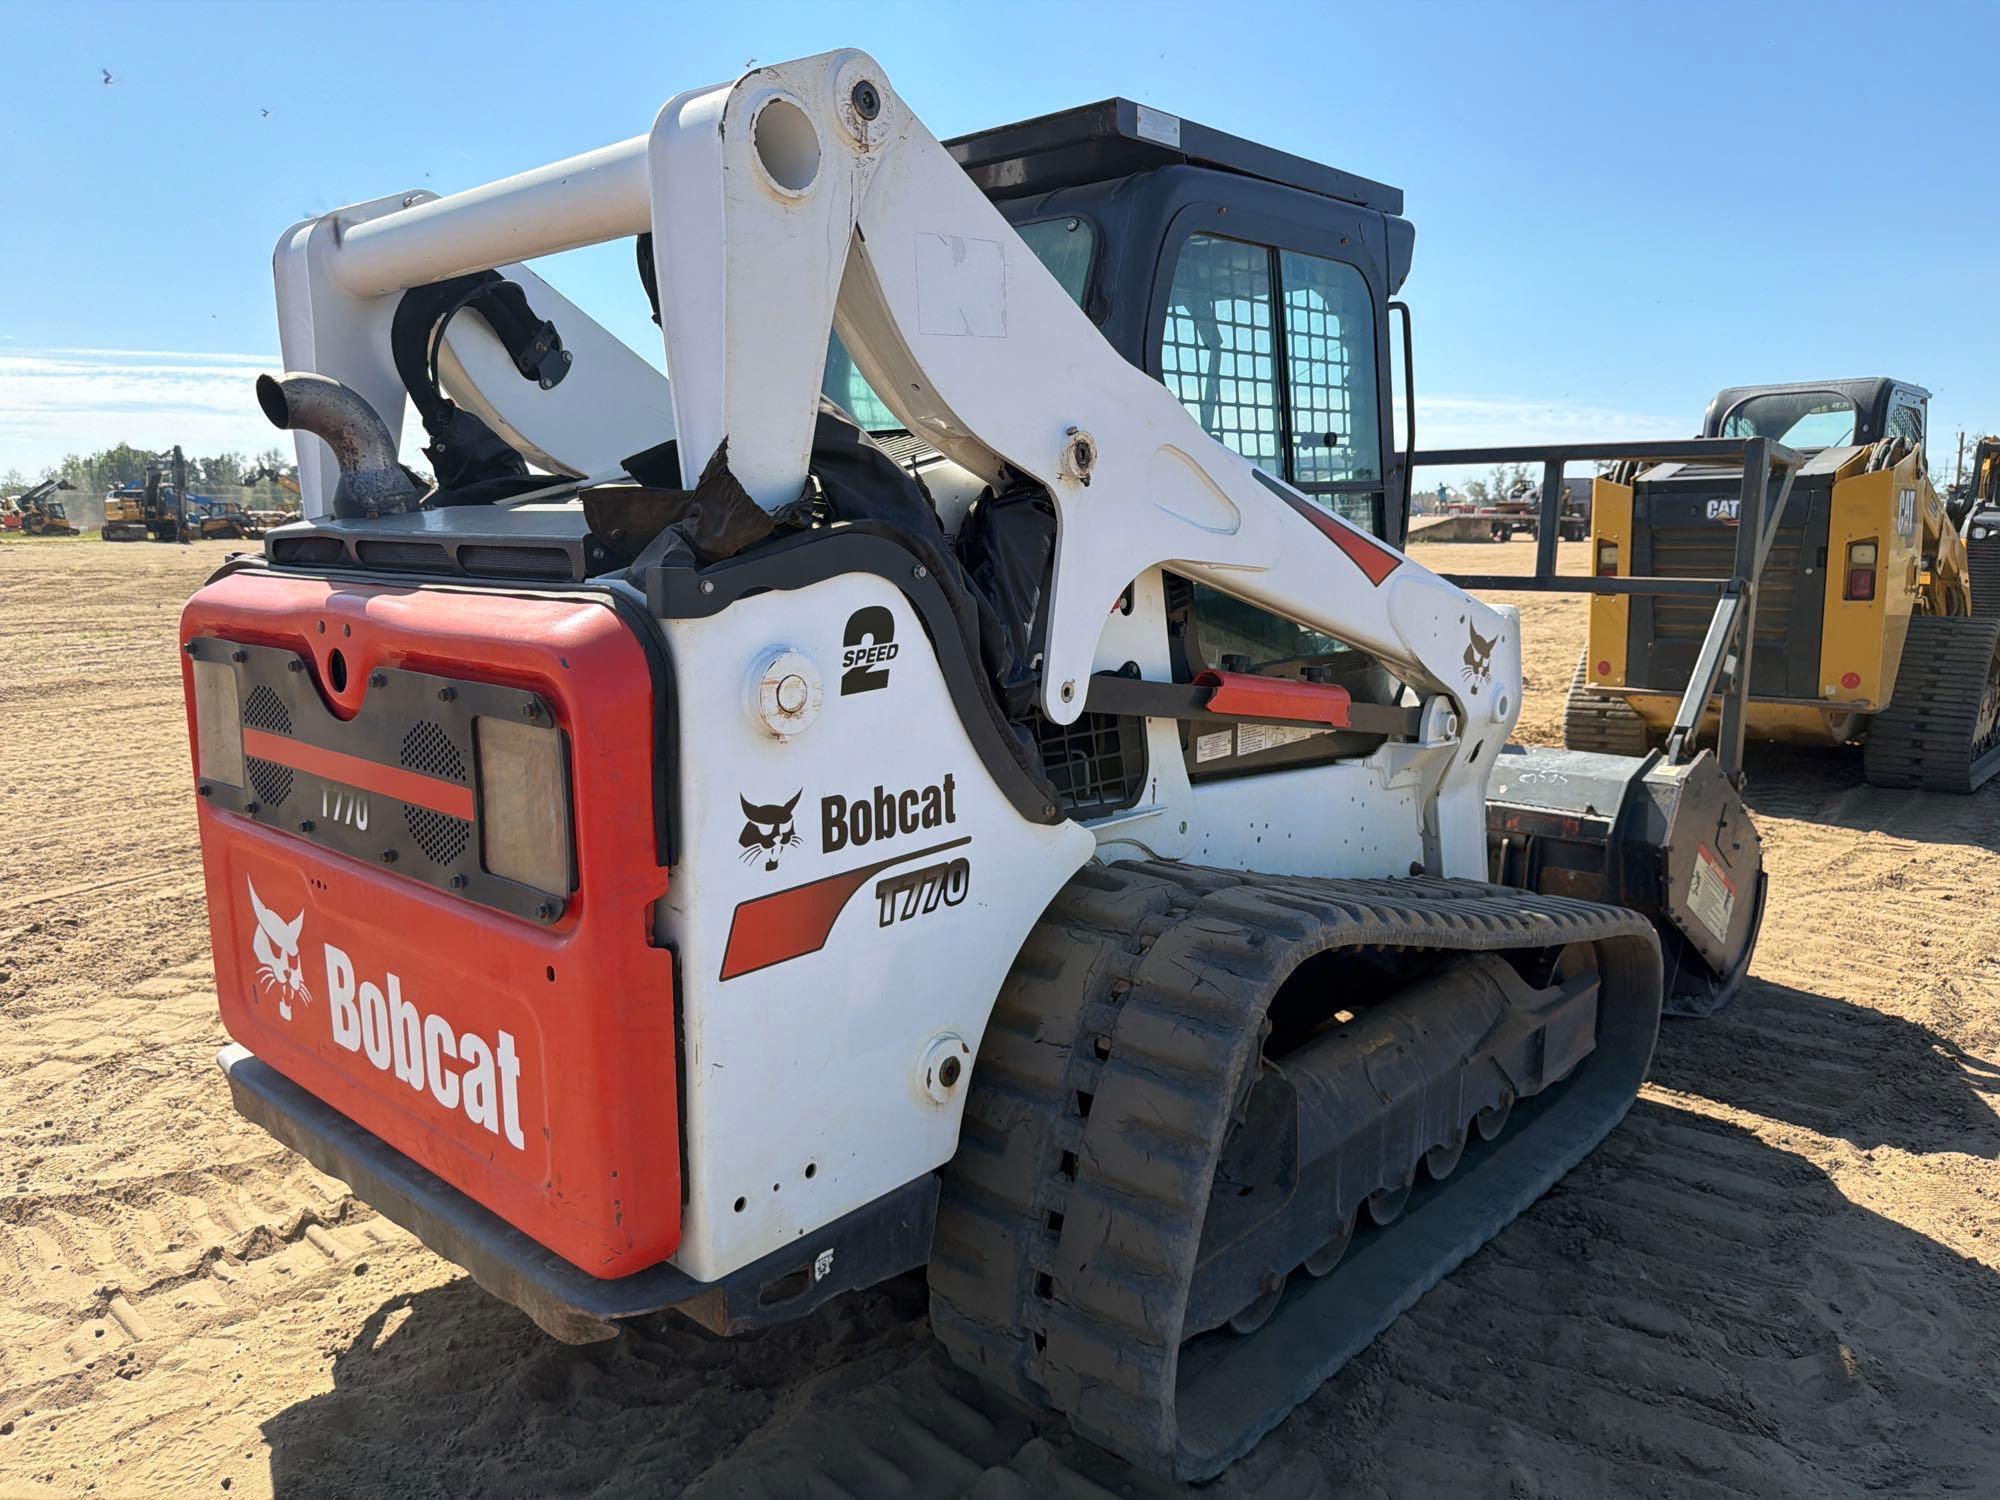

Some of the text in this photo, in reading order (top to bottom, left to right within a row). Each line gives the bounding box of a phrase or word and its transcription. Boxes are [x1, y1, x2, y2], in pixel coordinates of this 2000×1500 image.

[1706, 499, 1741, 520] CAT
[1898, 489, 1916, 535] CAT
[840, 605, 895, 696] 2
[841, 642, 899, 668] SPEED
[820, 773, 956, 854] Bobcat
[875, 857, 971, 928] T770
[324, 942, 525, 1151] Bobcat
